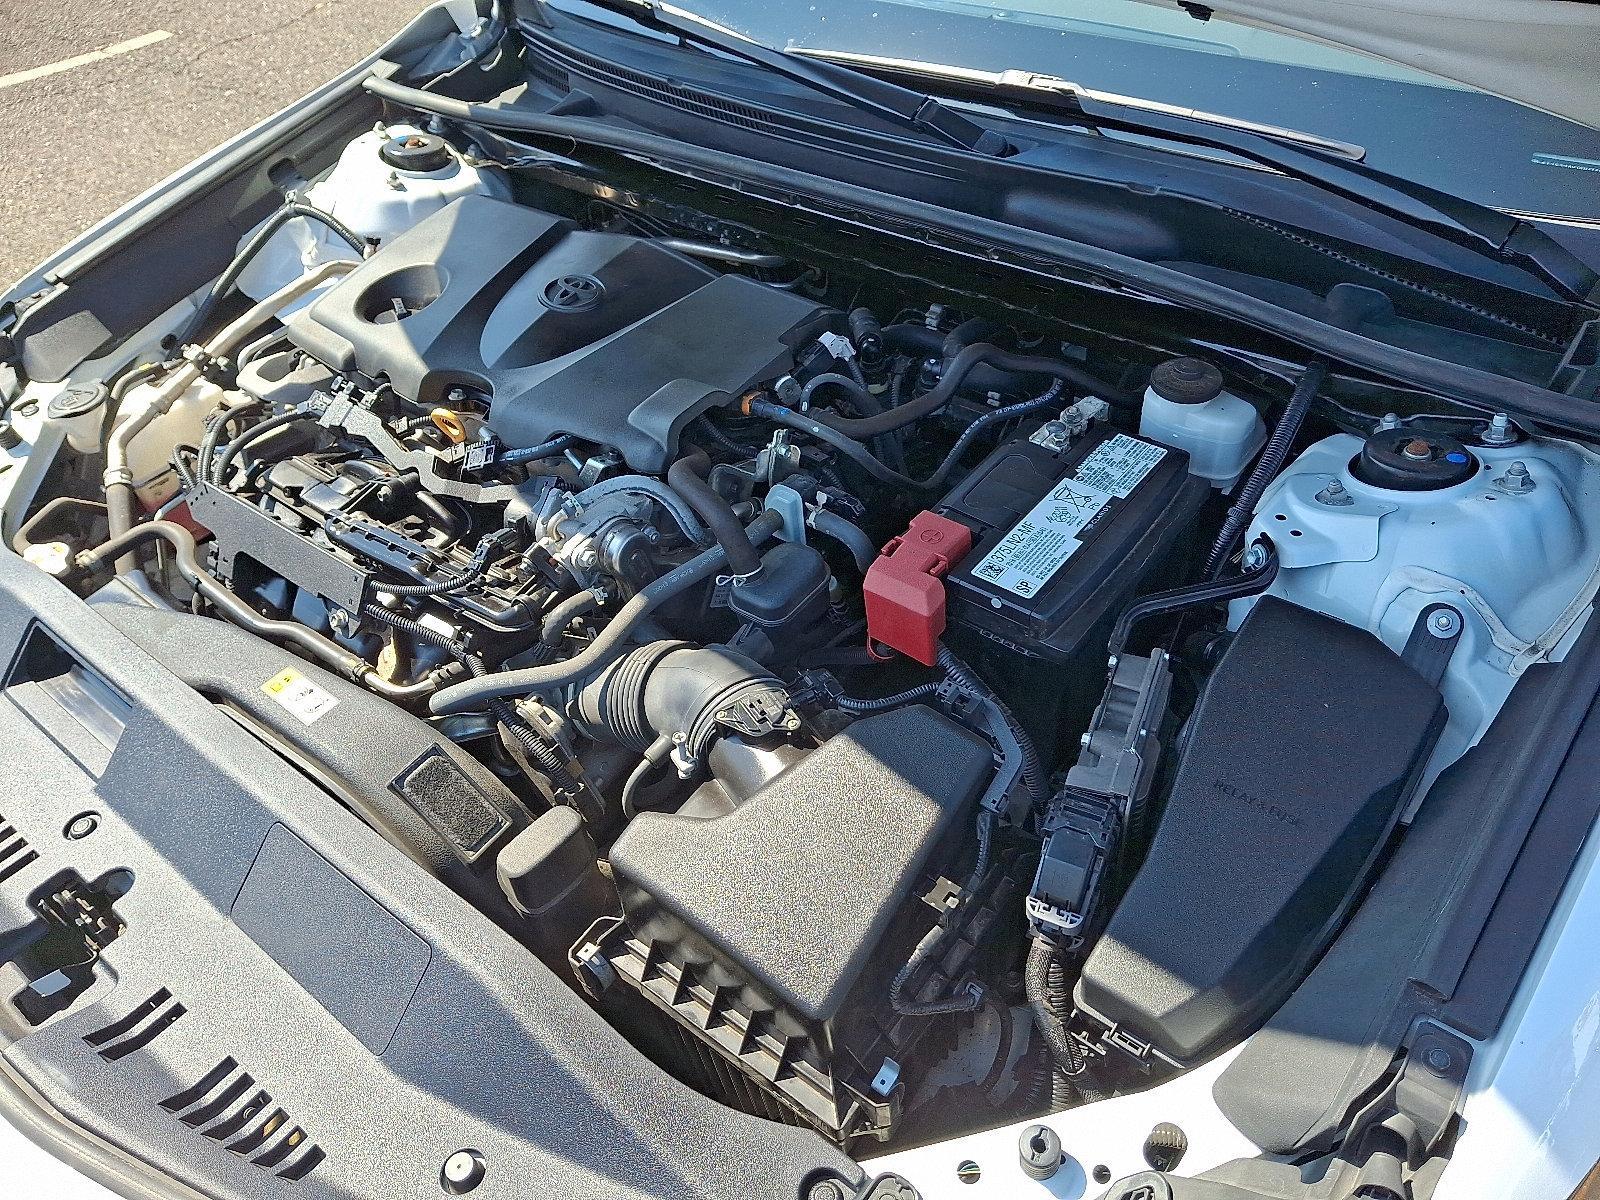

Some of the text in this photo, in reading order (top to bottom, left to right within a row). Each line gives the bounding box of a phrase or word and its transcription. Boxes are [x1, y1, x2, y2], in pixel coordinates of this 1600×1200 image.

[991, 521, 1035, 562] 375LN2-MF
[1016, 580, 1033, 594] SP
[1213, 779, 1258, 804] RELAY
